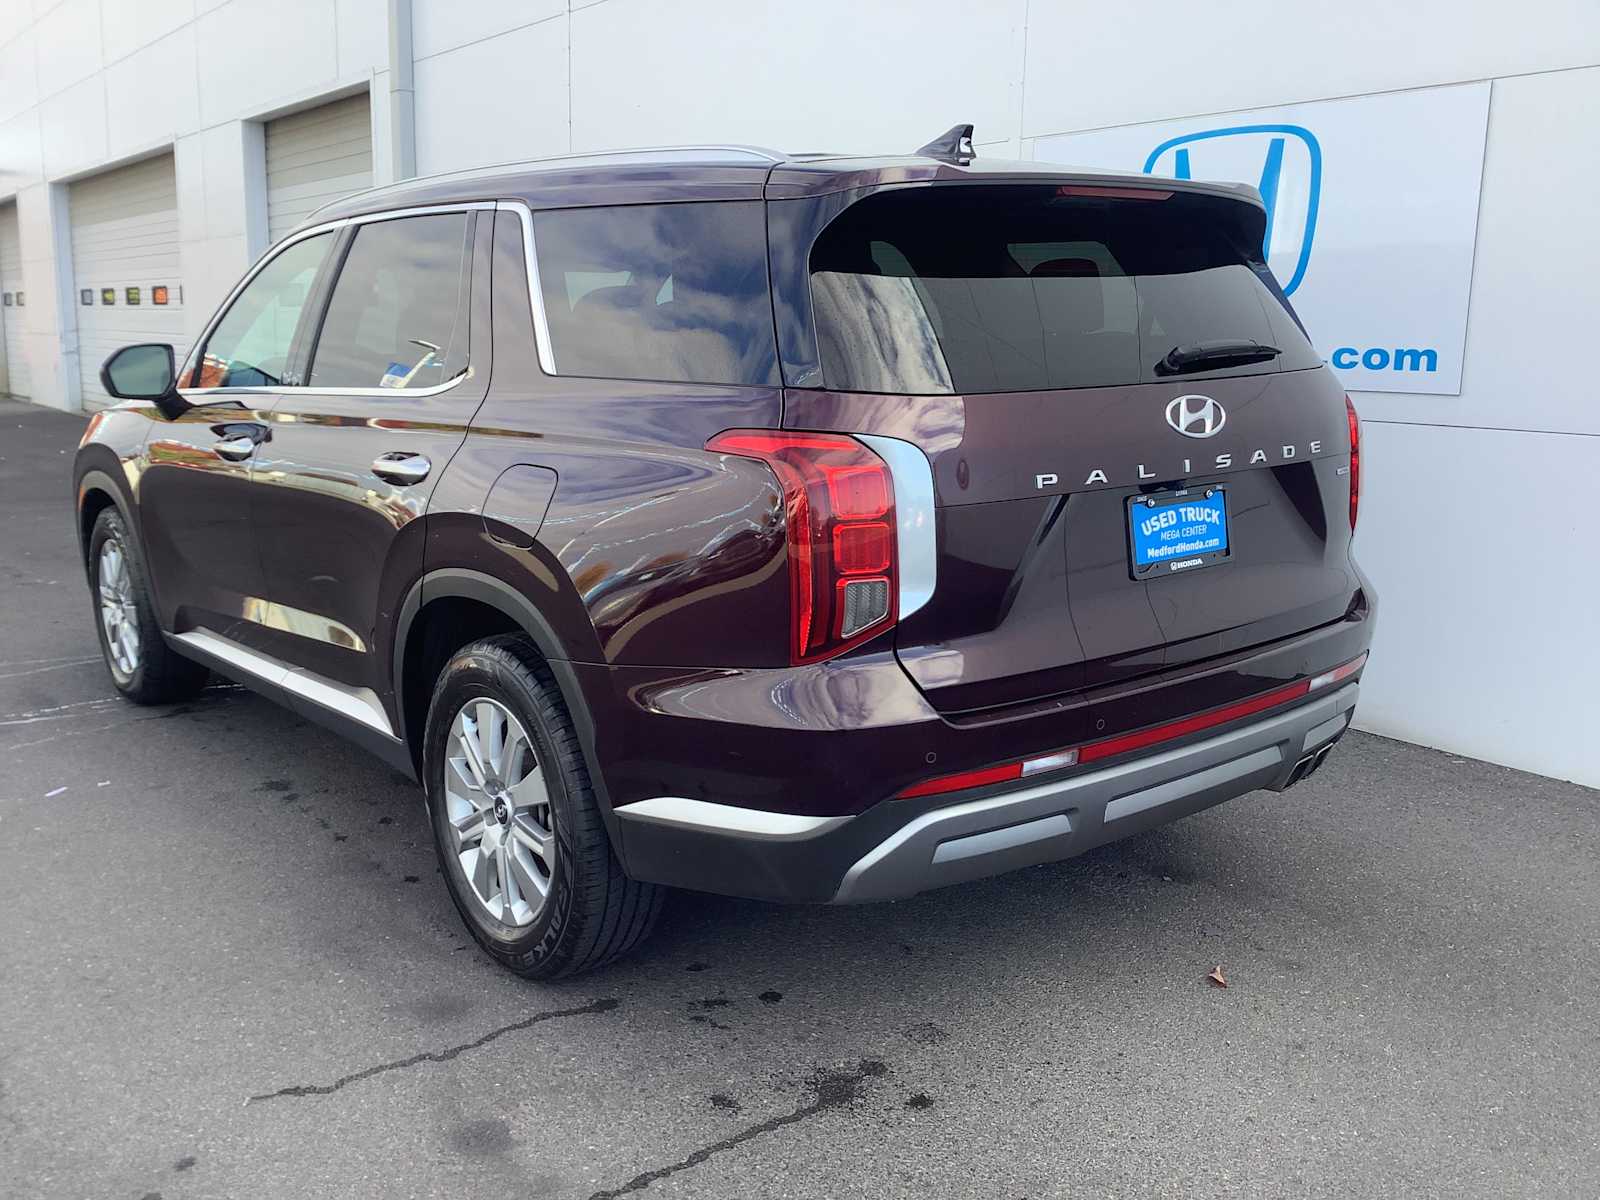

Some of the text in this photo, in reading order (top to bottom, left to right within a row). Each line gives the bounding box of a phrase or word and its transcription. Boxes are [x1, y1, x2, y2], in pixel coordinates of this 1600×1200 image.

[1323, 347, 1438, 371] com
[1036, 440, 1321, 489] PALISADE
[1141, 507, 1221, 536] USED TRUCK
[1160, 524, 1208, 541] MEGA CENTER
[1147, 538, 1220, 559] MedfordHonda.com
[1177, 558, 1203, 568] HONDA
